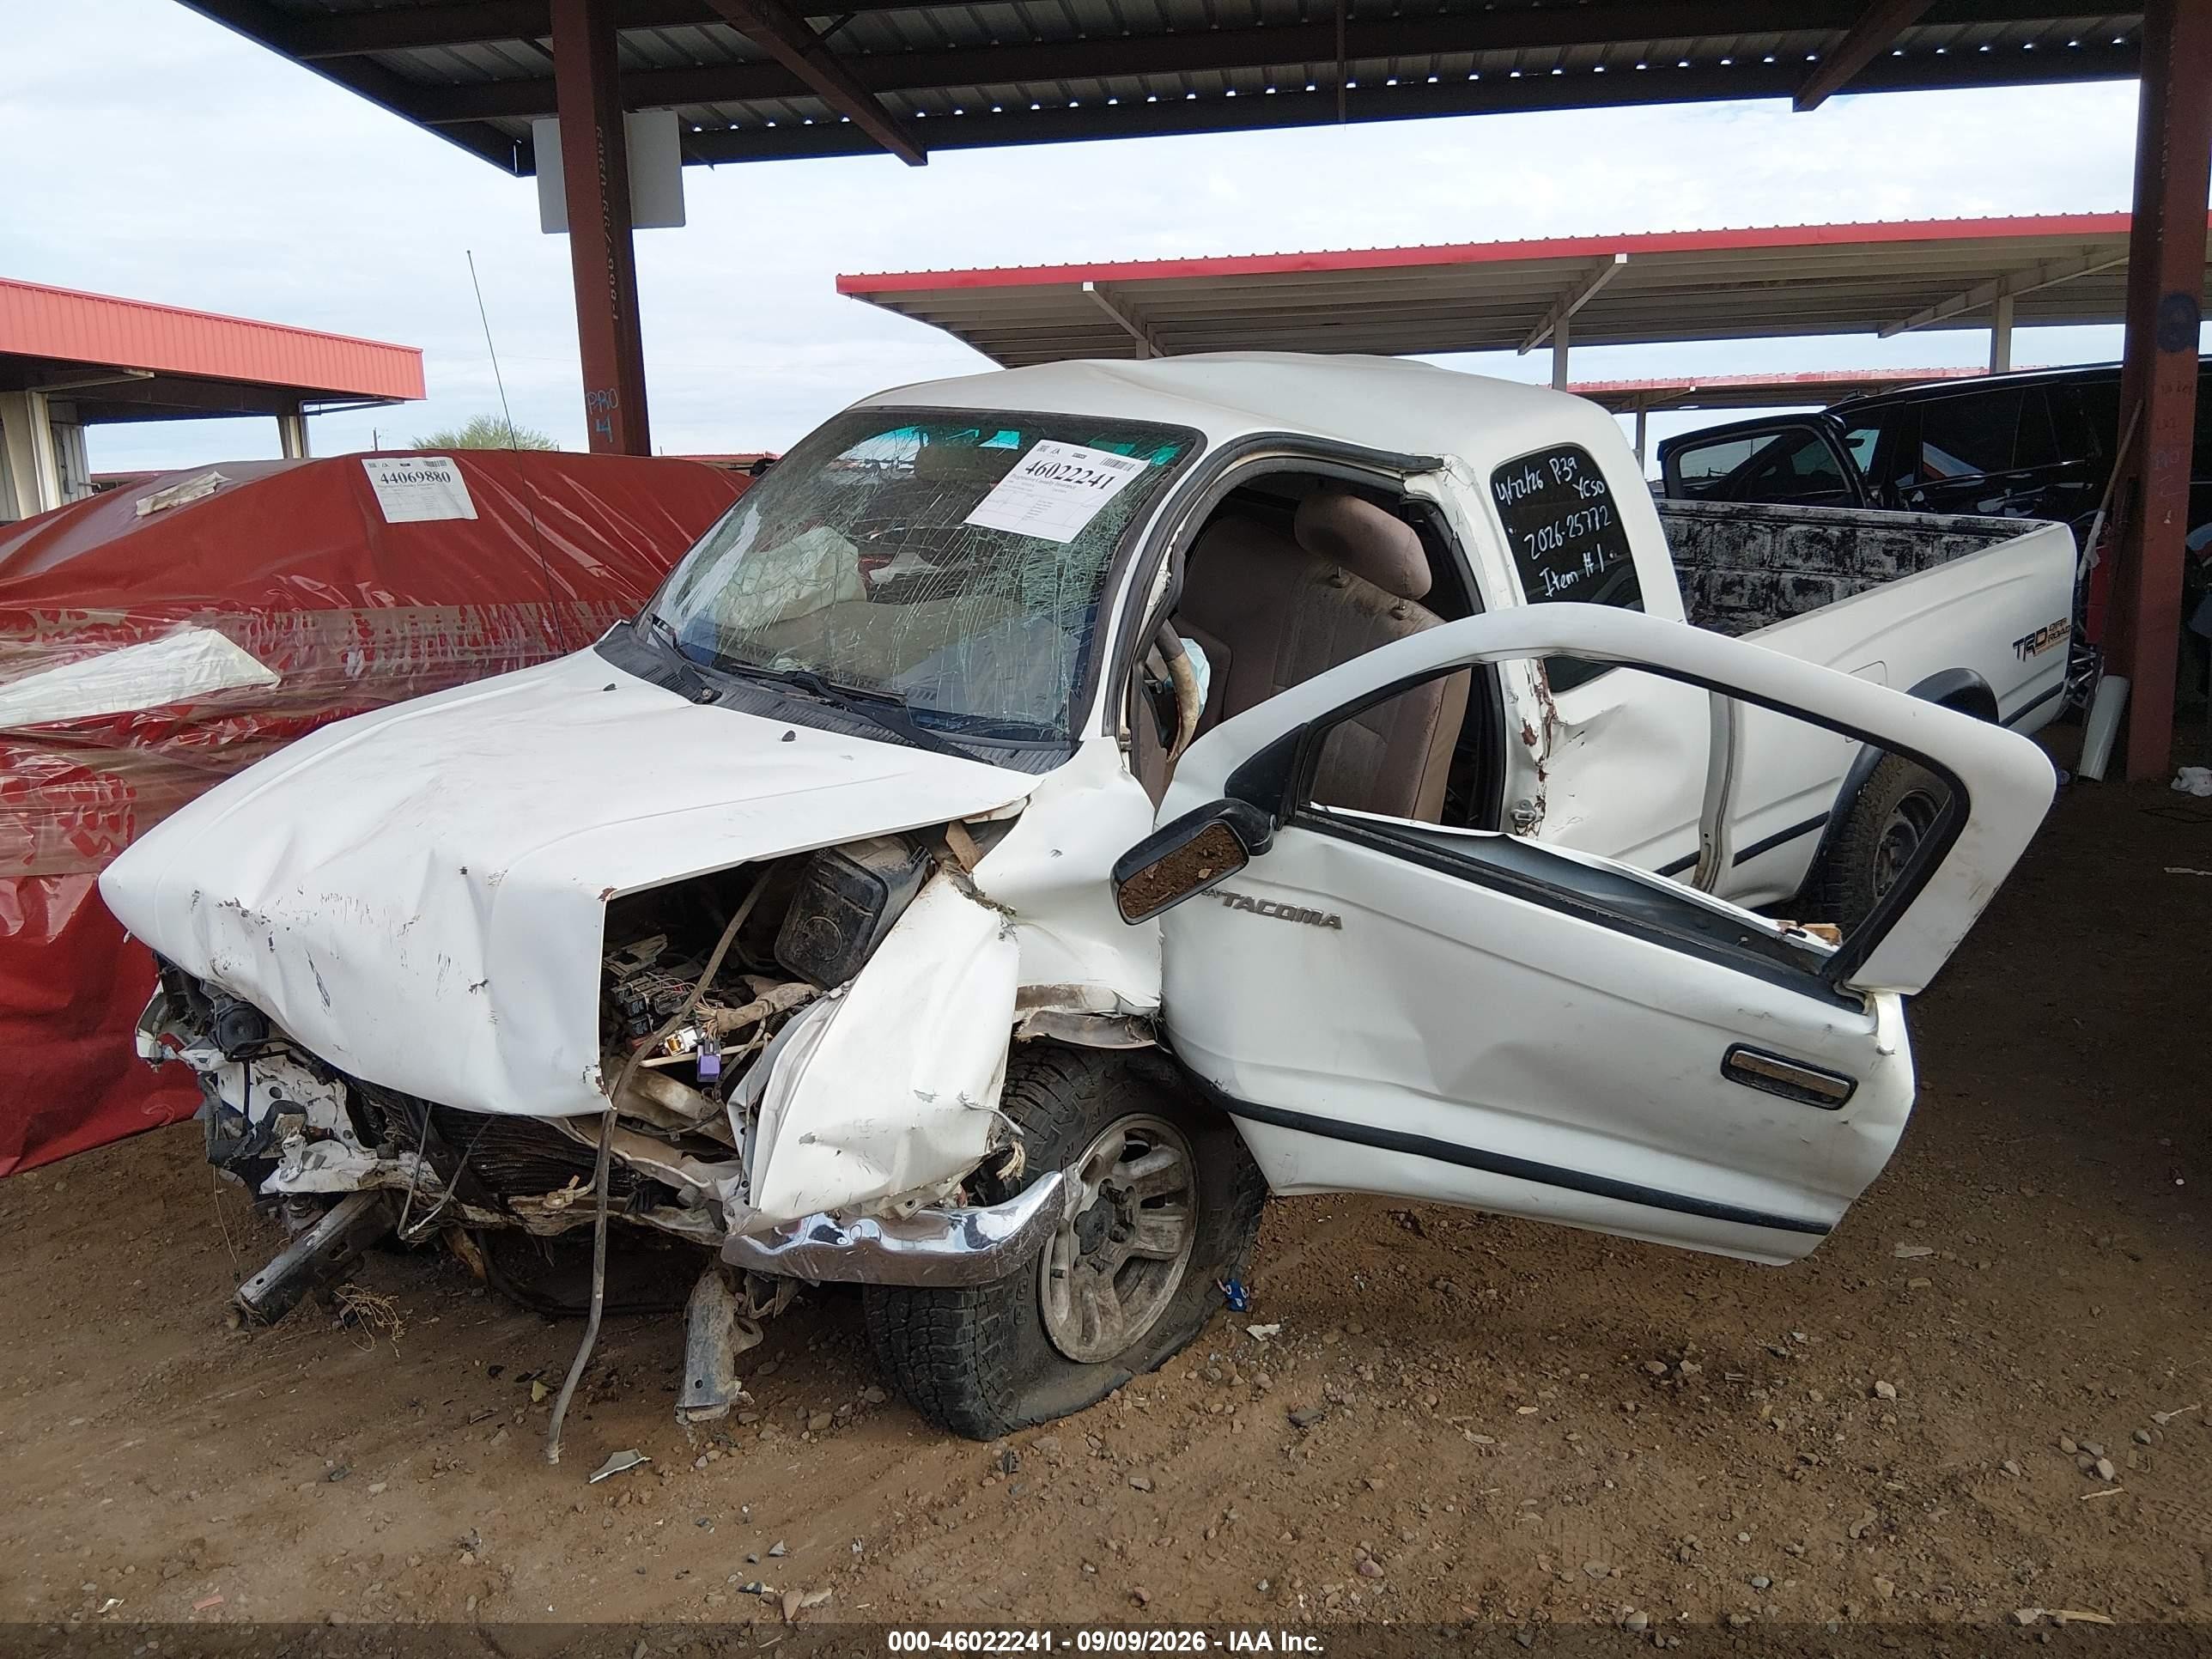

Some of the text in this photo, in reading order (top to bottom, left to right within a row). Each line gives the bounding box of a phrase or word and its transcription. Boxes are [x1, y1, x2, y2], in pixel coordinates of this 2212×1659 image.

[380, 470, 452, 484] 44069880
[1024, 459, 1117, 490] 46022241
[1495, 465, 1544, 506] 4/22/26
[1539, 567, 1579, 598] Item
[2049, 617, 2068, 632] OFF
[2012, 626, 2048, 663] TRD
[1221, 890, 1343, 930] TACOMA
